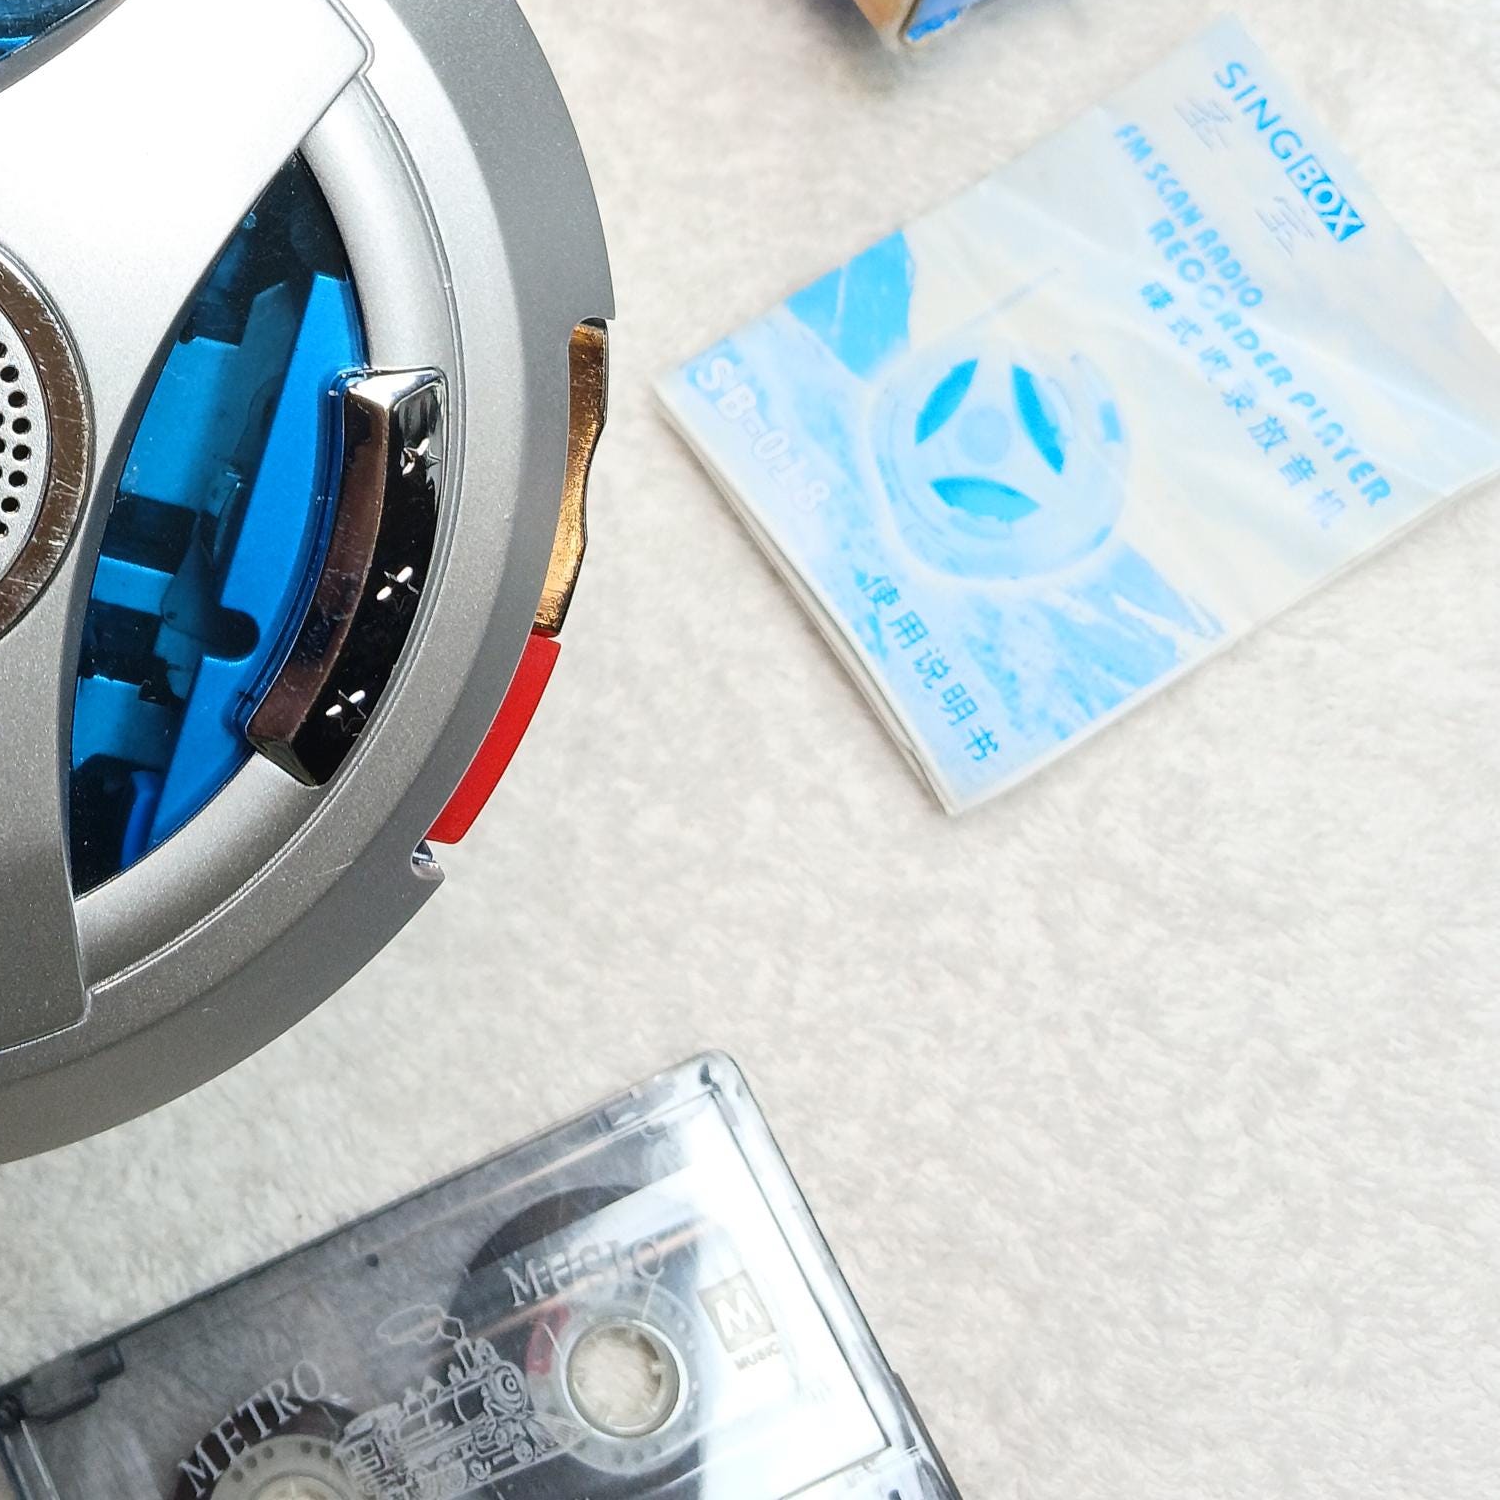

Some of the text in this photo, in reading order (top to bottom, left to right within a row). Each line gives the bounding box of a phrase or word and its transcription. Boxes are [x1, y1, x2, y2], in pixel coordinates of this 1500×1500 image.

[1114, 124, 1263, 308] FM SCAN RADIO
[695, 356, 831, 513] SB-018
[1149, 218, 1391, 506] RECORDER PLAYER
[860, 575, 999, 762] 使用说明书
[178, 1359, 326, 1499] METRO
[733, 1340, 782, 1371] MUSIC
